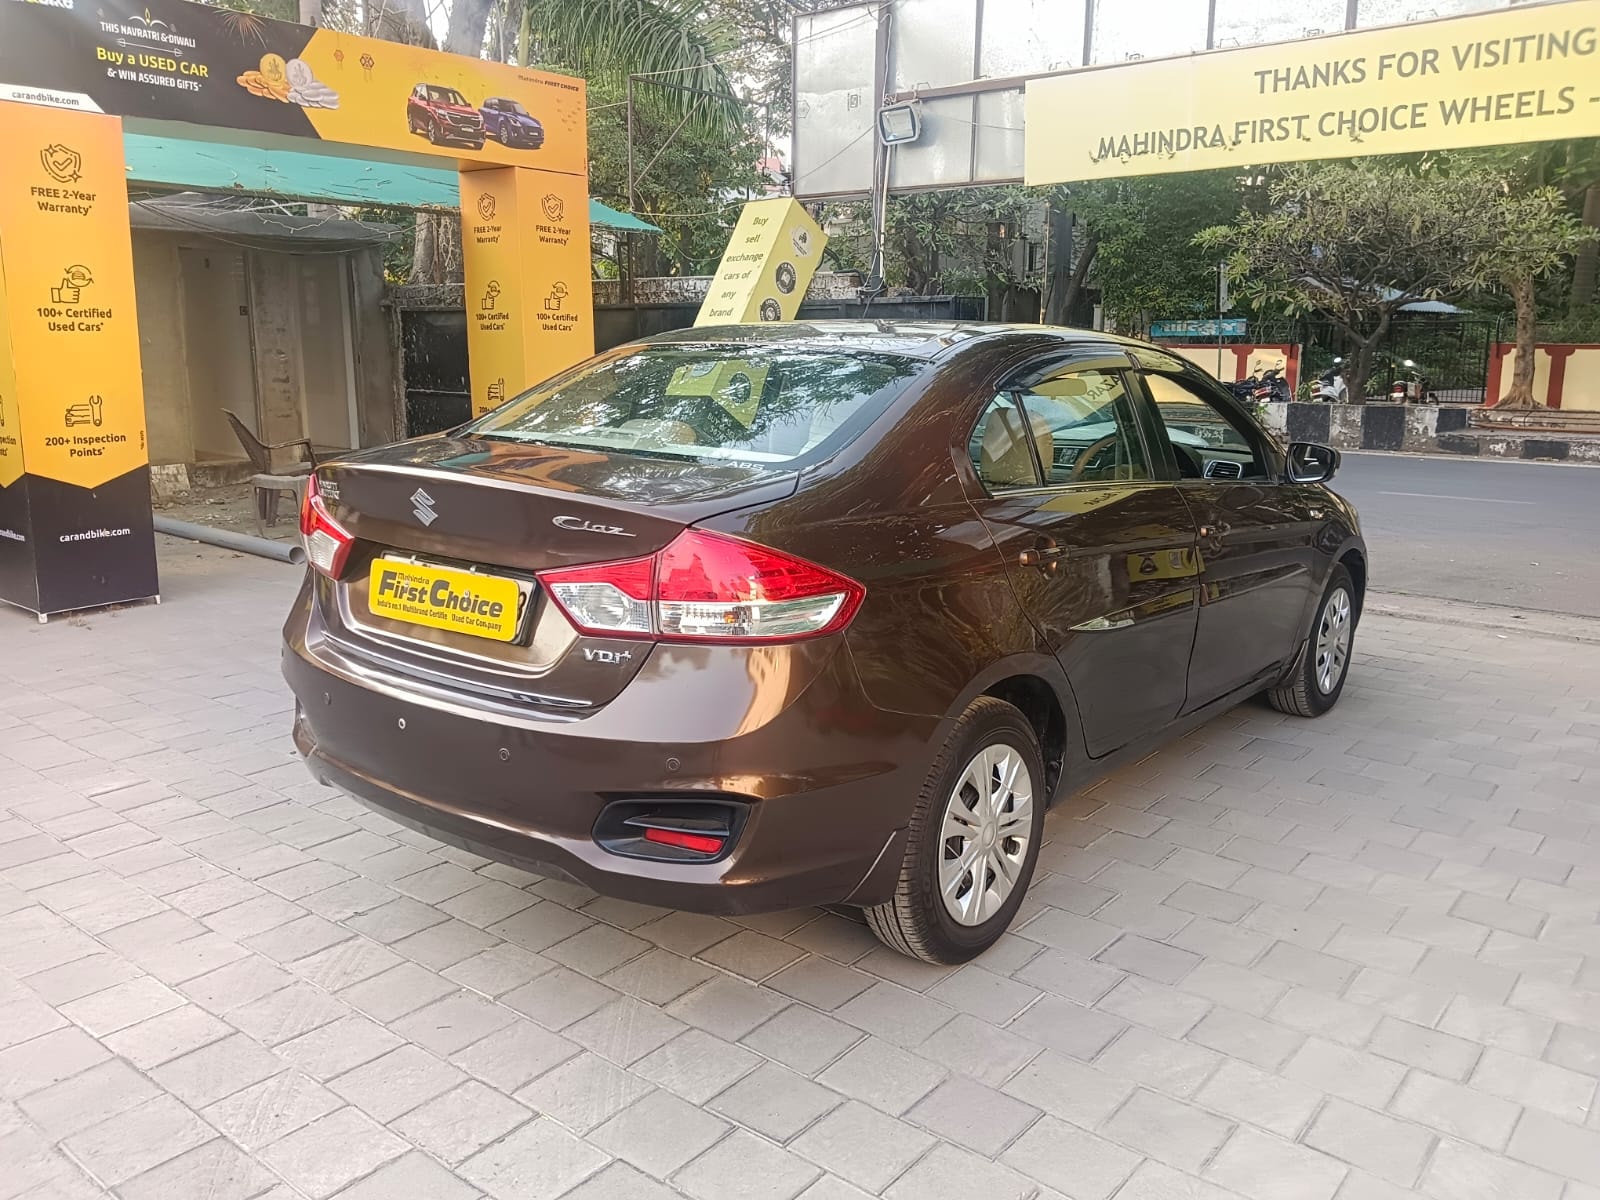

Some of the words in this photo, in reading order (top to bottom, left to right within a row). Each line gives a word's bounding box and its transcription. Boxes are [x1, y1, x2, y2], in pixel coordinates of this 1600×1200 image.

[100, 22, 119, 33] THIS
[120, 26, 160, 41] NAVRATRI
[96, 46, 124, 65] Buy
[128, 54, 136, 64] a
[139, 54, 176, 72] USED
[180, 61, 208, 78] CAR
[1254, 57, 1366, 94] THANKS
[1378, 48, 1440, 82] FOR
[1452, 27, 1598, 71] VISITING
[107, 68, 117, 78] &
[118, 70, 136, 81] WIN
[138, 72, 176, 87] ASSURED
[12, 92, 80, 106] carandbike.com
[1098, 123, 1226, 160] MAHINDRA
[1234, 115, 1310, 145] FIRST
[1318, 103, 1427, 137] CHOICE
[1439, 86, 1576, 125] WHEELS
[30, 186, 60, 199] FREE
[62, 190, 96, 202] 2-Year
[752, 216, 768, 226] Buy
[474, 226, 486, 234] FREE
[536, 225, 552, 234] FREE
[552, 226, 571, 235] 2-Year
[745, 234, 760, 243] sell
[726, 253, 764, 263] exchange
[742, 270, 752, 279] of
[721, 290, 736, 300] any
[36, 308, 63, 318] 100+
[65, 308, 112, 318] Certified
[488, 312, 510, 320] Certified
[552, 314, 578, 322] Certified
[709, 308, 734, 317] brand
[48, 322, 76, 332] Used
[45, 436, 70, 446] 200+
[73, 433, 126, 446] Inspection
[726, 460, 765, 470] ABS
[552, 516, 637, 537] Ciaz
[60, 528, 130, 542] carandbike.com
[398, 572, 430, 586] Mahindra
[378, 570, 429, 604] First
[430, 579, 503, 618] Choice
[402, 604, 429, 616] Multibrand
[452, 613, 466, 624] Used
[466, 616, 476, 626] Car
[476, 618, 502, 632] Company
